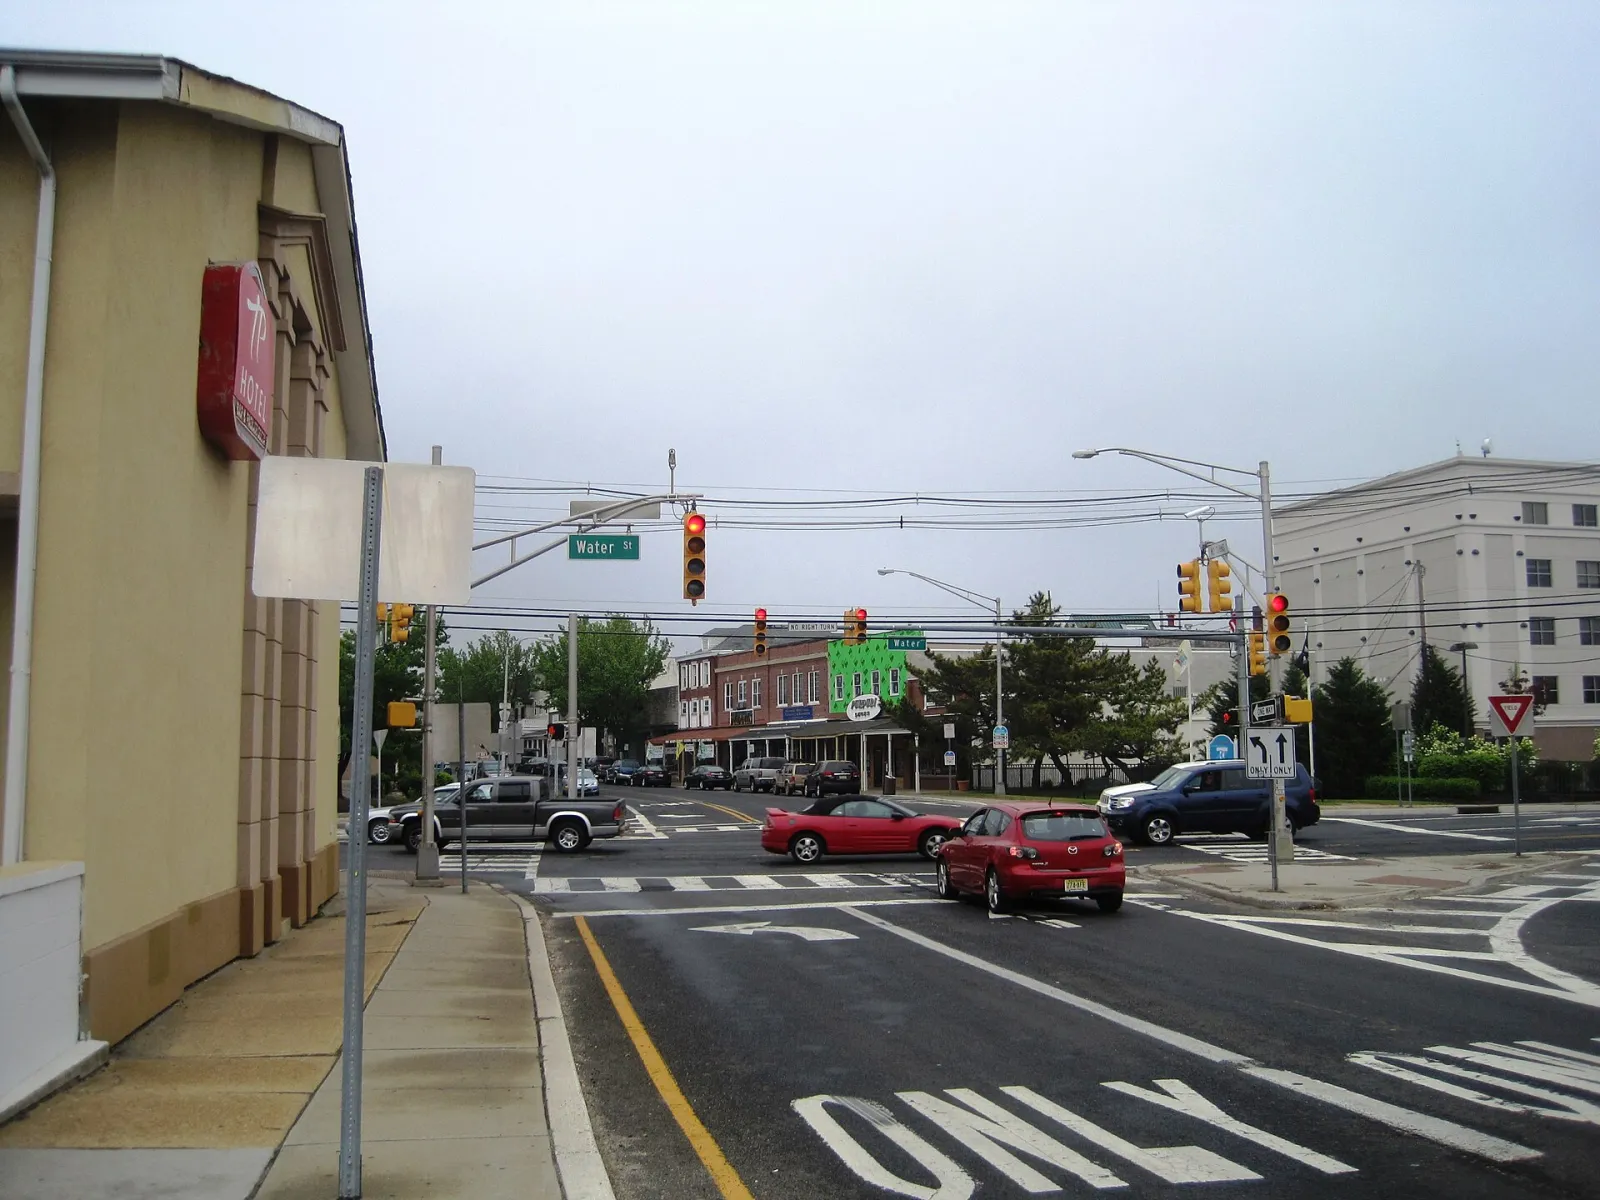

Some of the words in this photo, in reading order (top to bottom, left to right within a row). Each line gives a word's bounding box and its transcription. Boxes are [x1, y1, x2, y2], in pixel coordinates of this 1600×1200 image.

[240, 366, 267, 424] HOTEL
[576, 540, 615, 554] Water
[623, 541, 632, 550] St
[893, 639, 919, 648] Water
[793, 1079, 1360, 1200] ONLY
